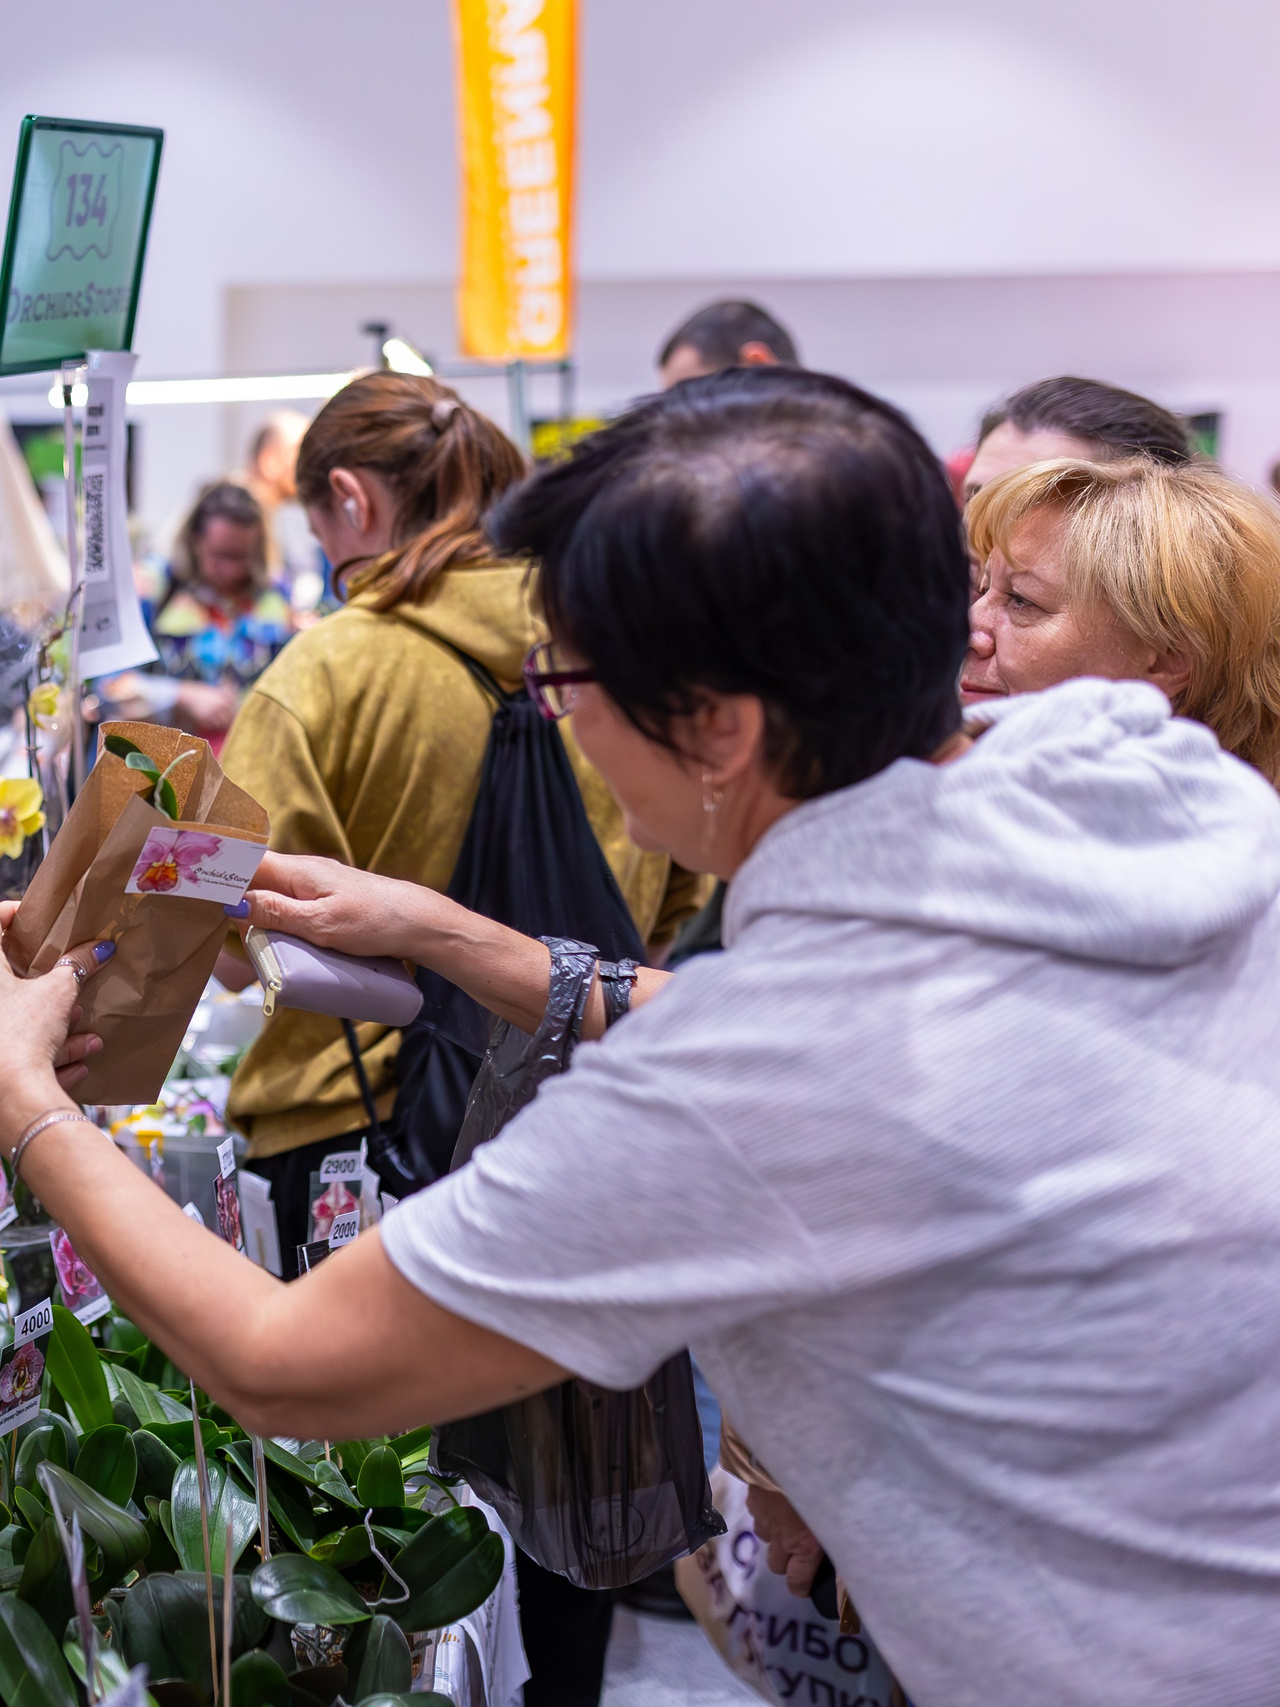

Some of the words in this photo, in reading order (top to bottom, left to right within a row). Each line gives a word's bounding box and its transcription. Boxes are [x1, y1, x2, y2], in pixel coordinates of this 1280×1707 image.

[66, 173, 108, 227] 134
[324, 1159, 356, 1174] 2900
[333, 1220, 357, 1240] 2000
[21, 1307, 51, 1336] 4000
